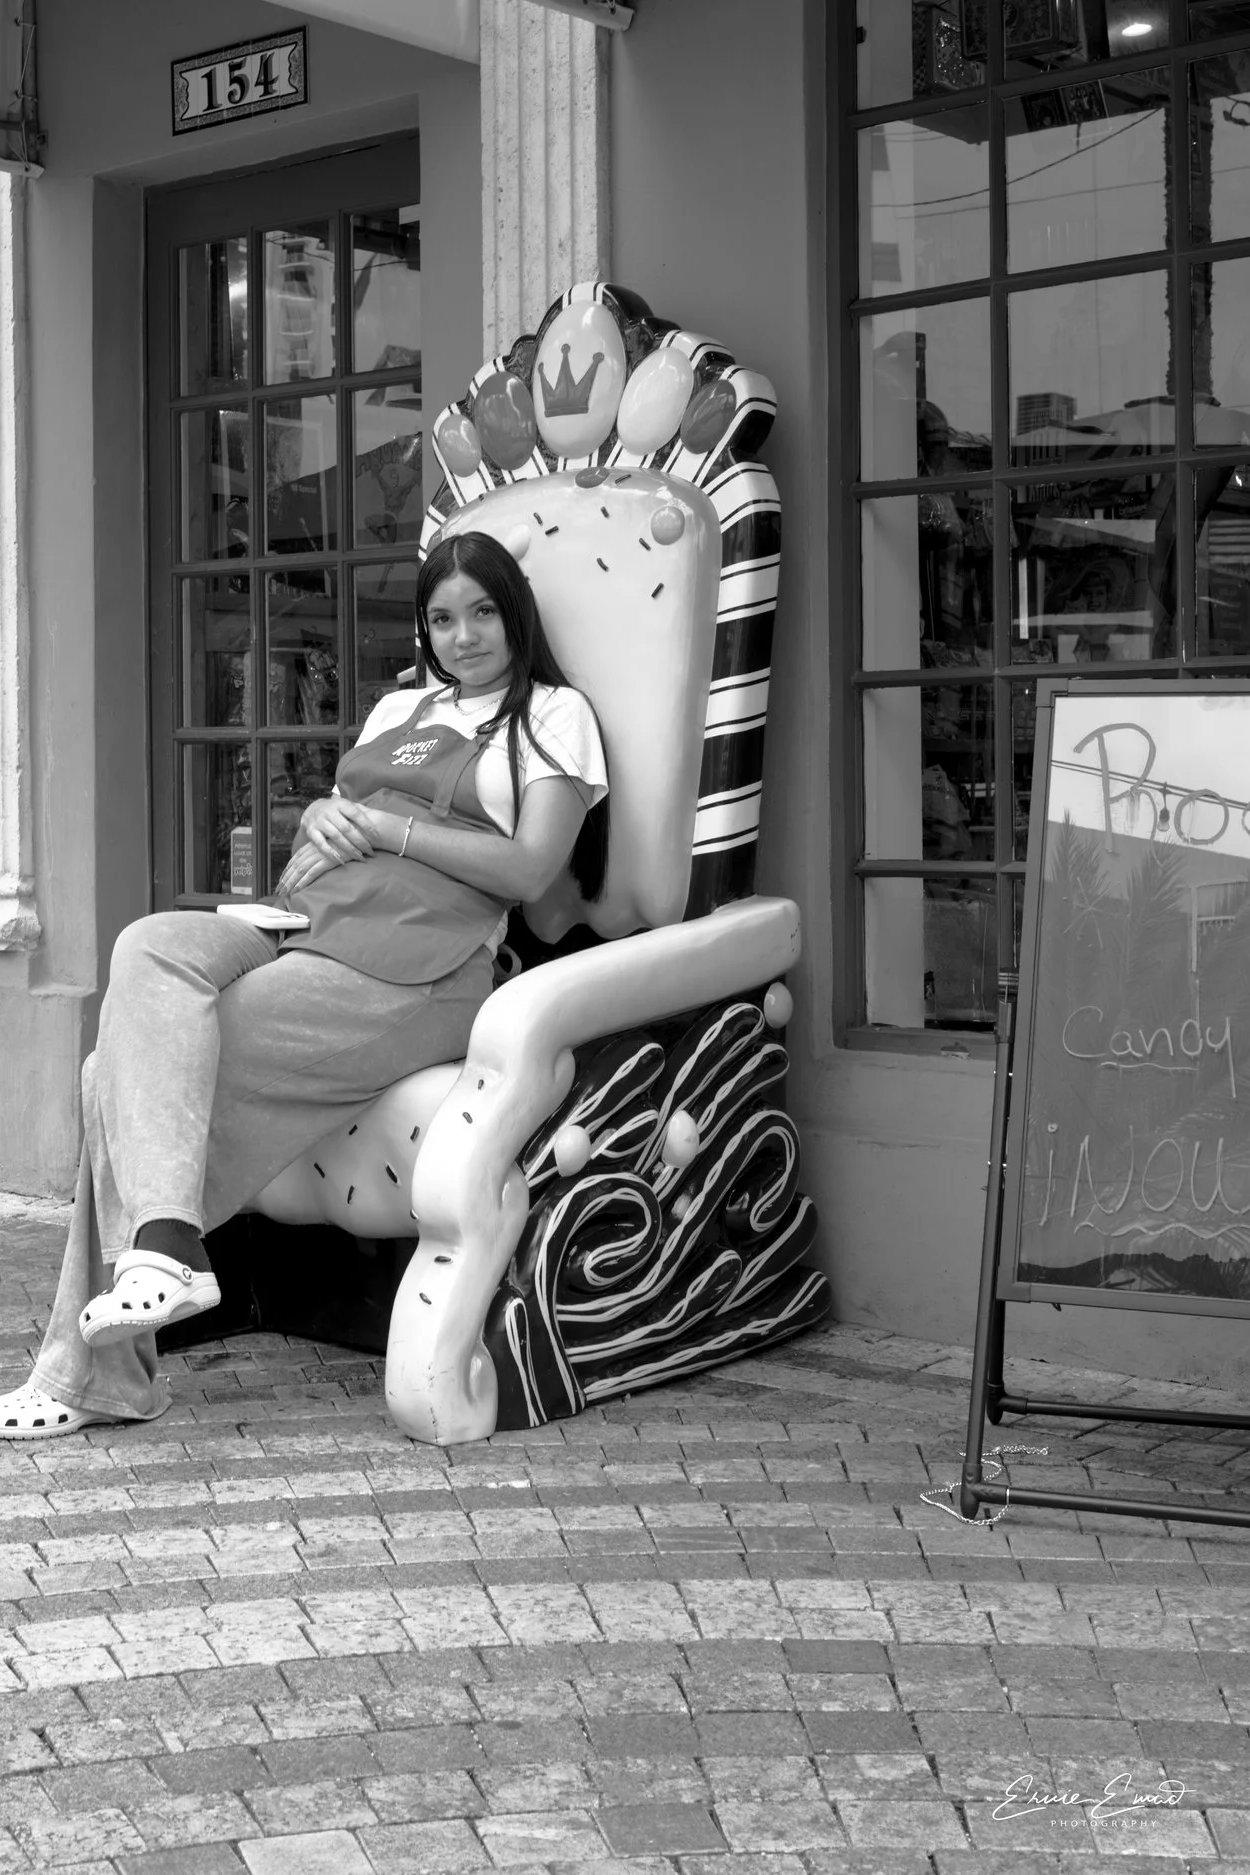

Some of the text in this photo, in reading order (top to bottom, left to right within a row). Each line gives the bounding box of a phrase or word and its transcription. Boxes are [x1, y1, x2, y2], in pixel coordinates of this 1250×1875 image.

[200, 51, 280, 112] 154
[1073, 722, 1250, 868] Ro
[1062, 1005, 1237, 1098] Candy
